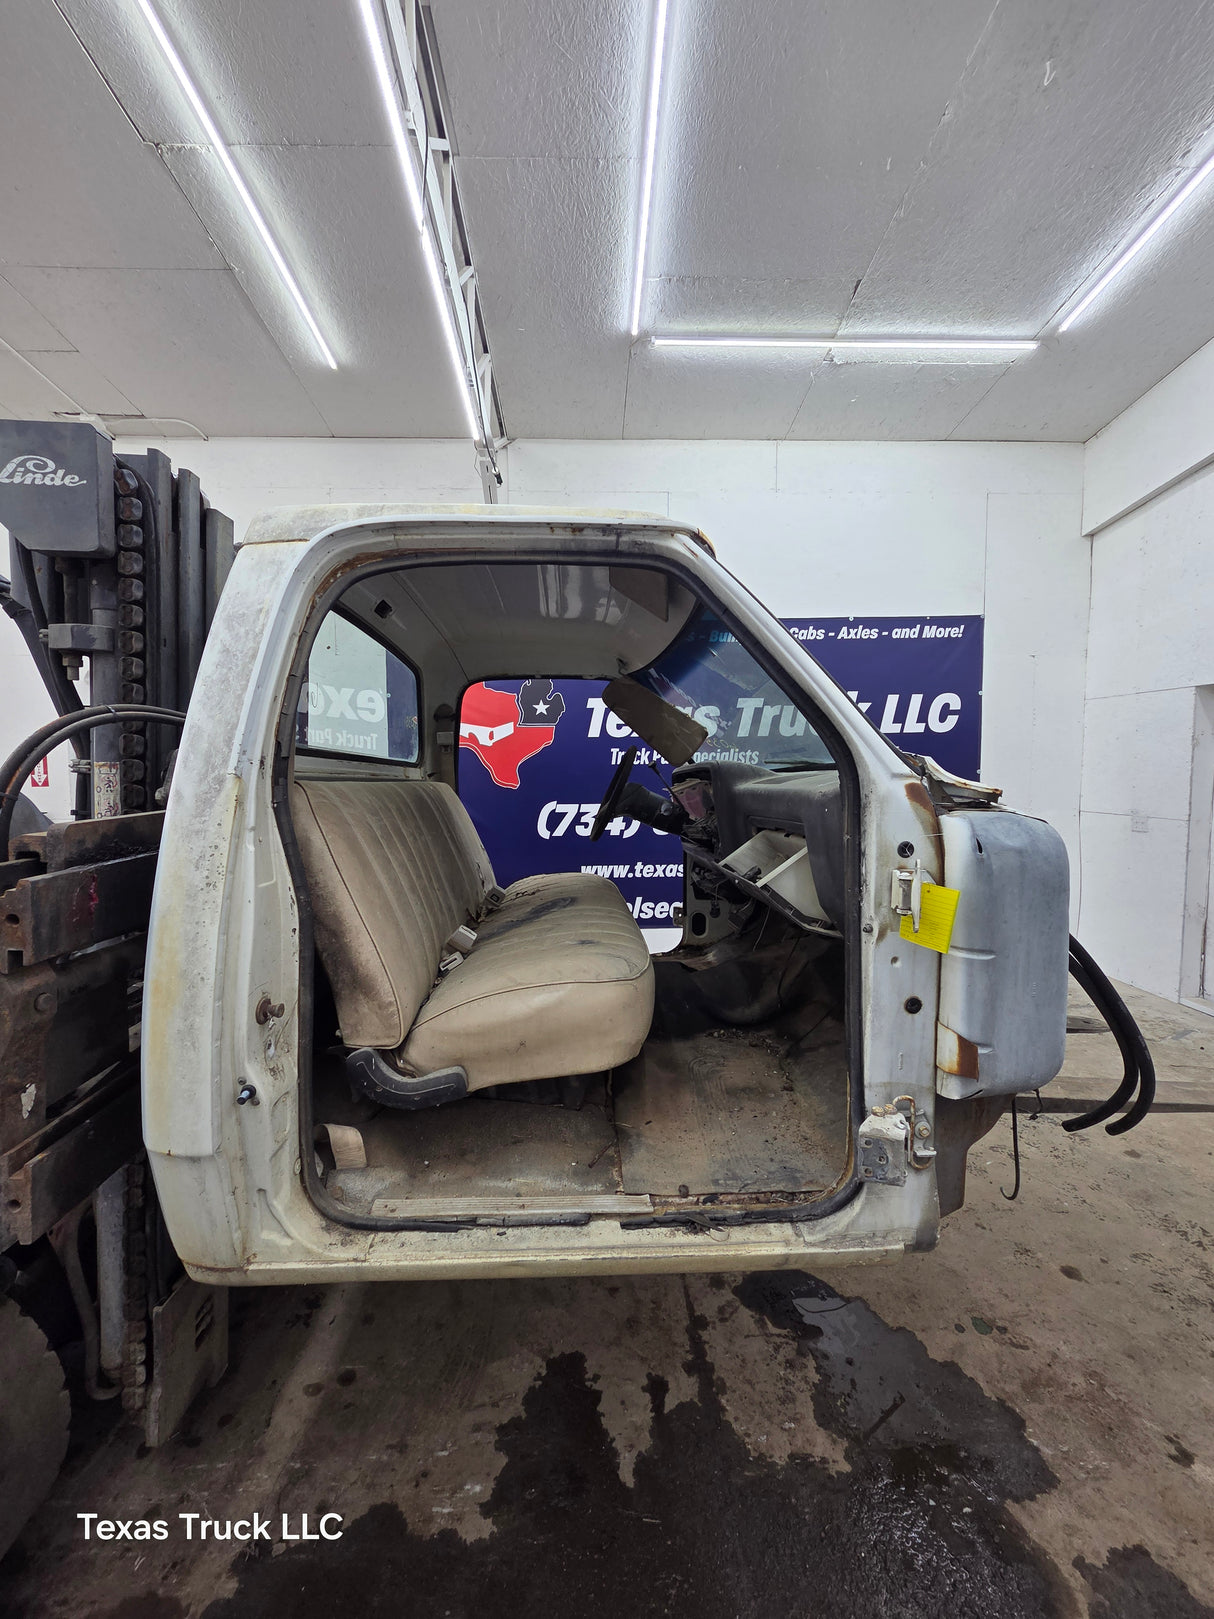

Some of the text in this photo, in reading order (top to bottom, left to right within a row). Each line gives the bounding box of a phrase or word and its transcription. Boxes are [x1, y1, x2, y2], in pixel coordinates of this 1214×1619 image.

[0, 455, 87, 487] Linde
[789, 625, 826, 640] Cabs
[837, 624, 879, 640] Axles
[891, 624, 919, 639] and
[922, 624, 965, 639] More!
[586, 697, 721, 738] Tes
[879, 692, 962, 734] LLC
[610, 747, 651, 765] Trck
[692, 748, 760, 765] pecialists
